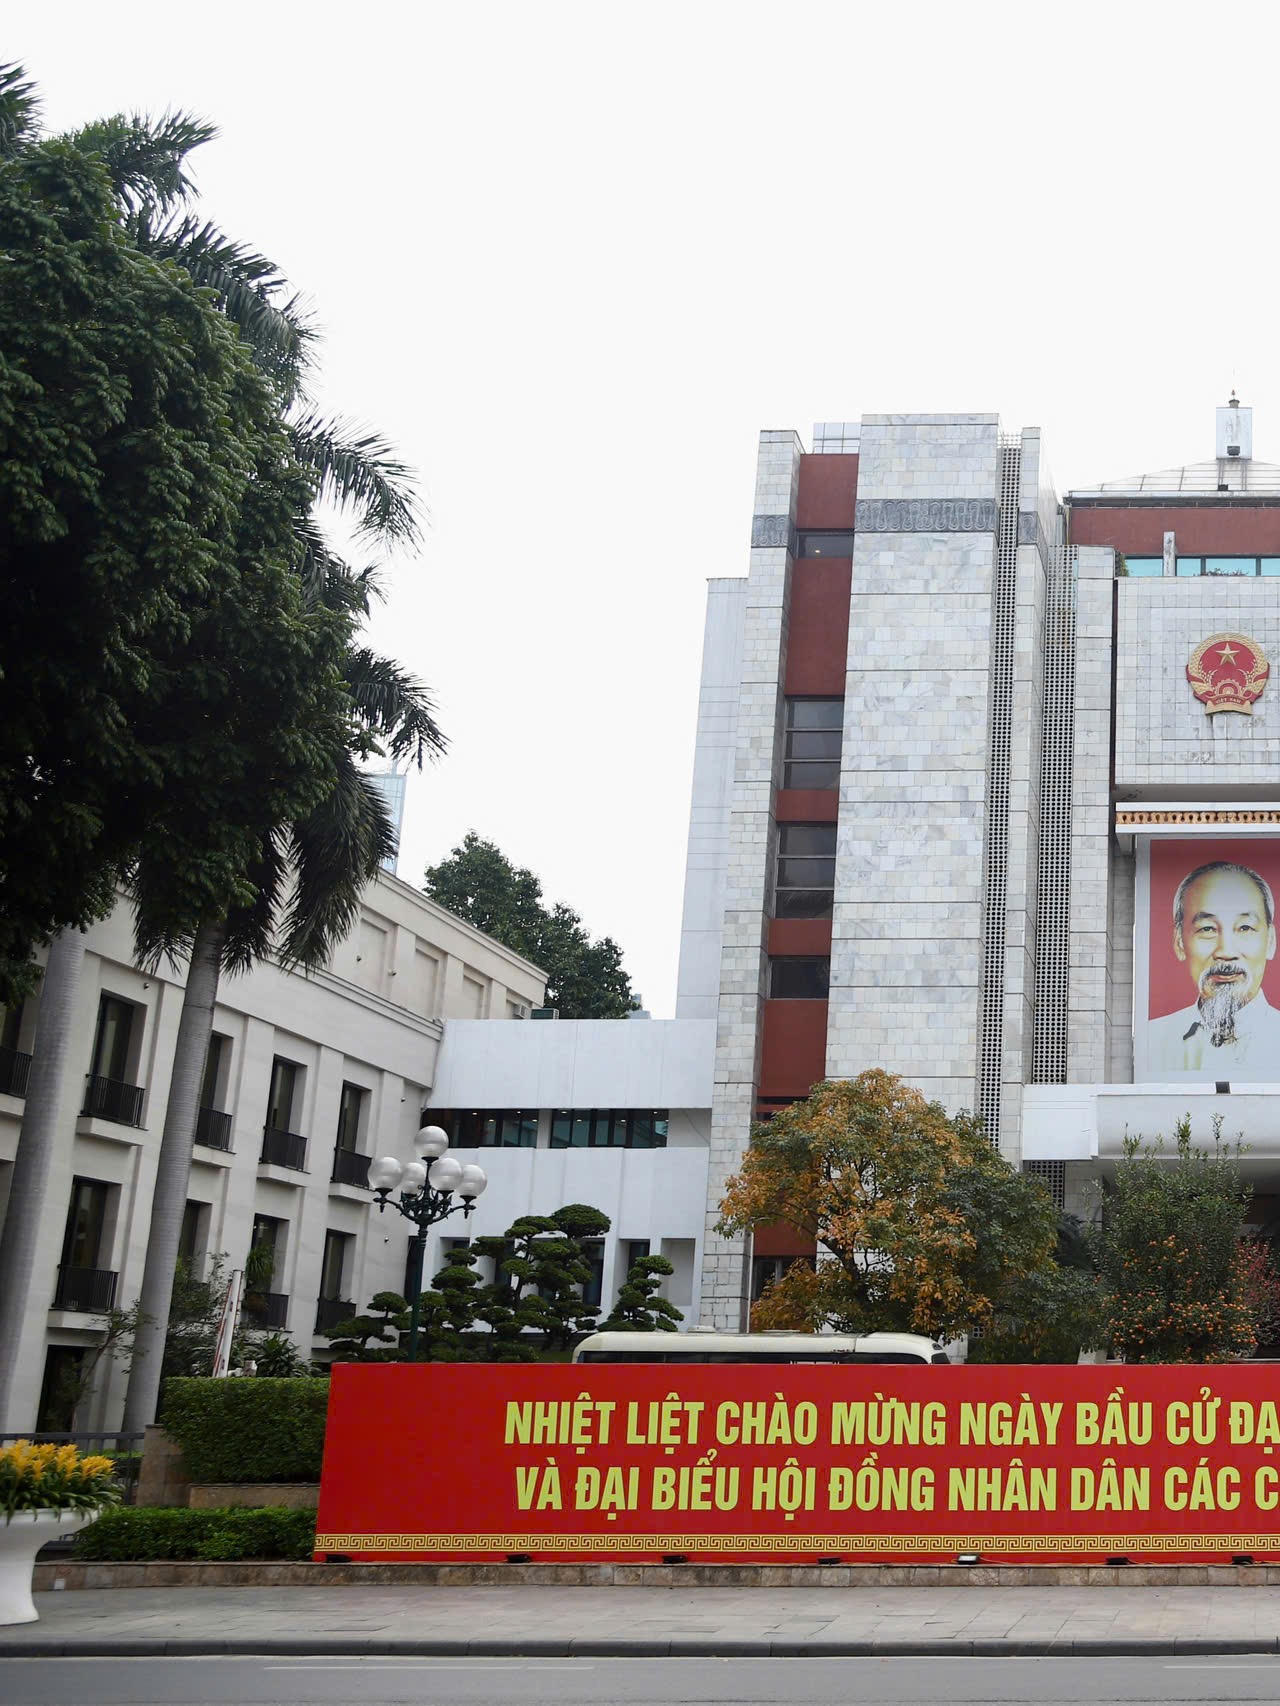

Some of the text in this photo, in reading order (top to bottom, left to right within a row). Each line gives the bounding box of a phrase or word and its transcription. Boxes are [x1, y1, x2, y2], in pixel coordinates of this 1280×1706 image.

[505, 1392, 615, 1454] NHIỆT
[627, 1392, 704, 1454] LIỆT
[716, 1392, 817, 1446] CHÀO
[832, 1392, 946, 1446] MỪNG
[960, 1392, 1063, 1446] NGÀY
[1076, 1386, 1153, 1446] BẦU
[1166, 1386, 1221, 1445] CỬ
[515, 1457, 563, 1510] VÀ
[575, 1466, 639, 1520] ĐẠI
[651, 1449, 740, 1511] BIỂU
[751, 1458, 817, 1521] HỘI
[827, 1451, 935, 1512] ĐỒNG
[948, 1458, 1056, 1511] NHÂN
[1071, 1458, 1150, 1511] DÂN
[1165, 1457, 1240, 1511] CÁC
